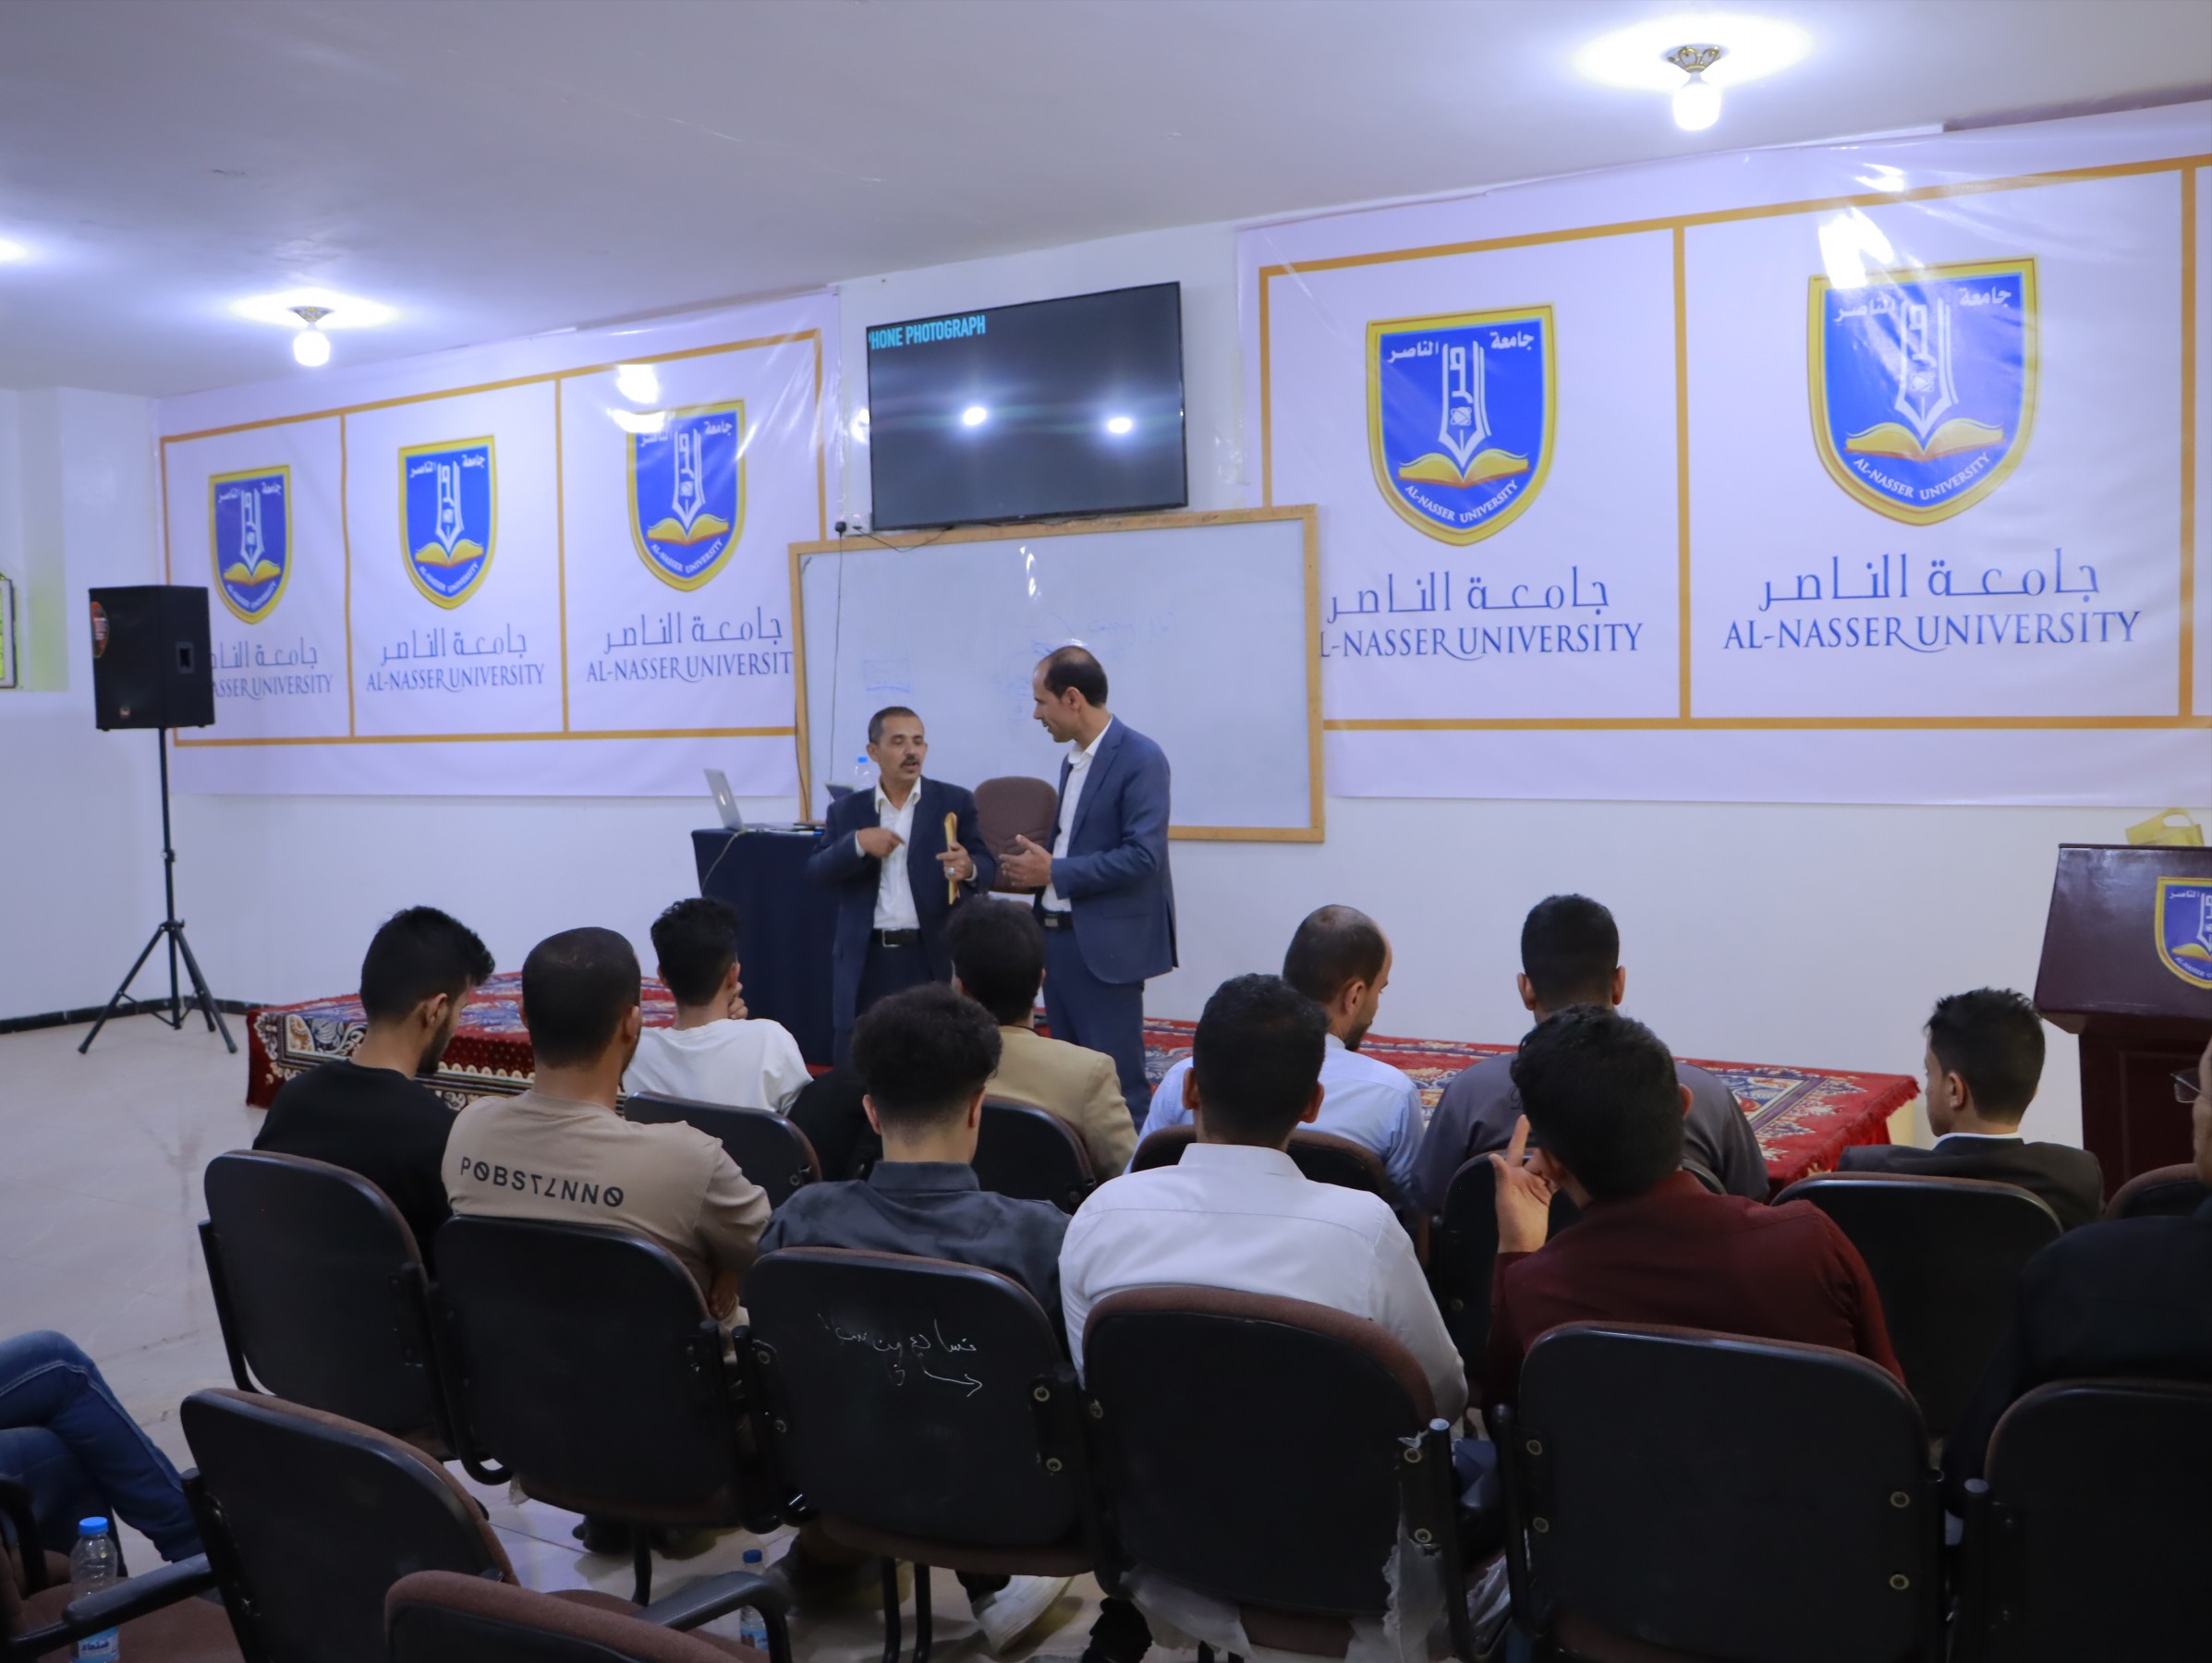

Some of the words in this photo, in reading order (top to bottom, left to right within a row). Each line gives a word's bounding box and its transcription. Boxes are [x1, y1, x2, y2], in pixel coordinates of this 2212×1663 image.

[1958, 286, 2012, 308] جامعة
[905, 315, 987, 346] PHOTOGRAPH
[1489, 331, 1535, 351] جامعة
[1388, 341, 1440, 364] الناصر
[703, 420, 733, 437] جامعة
[1853, 456, 1914, 499] AL-NASSER
[1919, 452, 1991, 501] UNIVERSITY
[1405, 484, 1456, 522] AL-NASSER
[1459, 479, 1519, 524] UNIVERSITY
[685, 538, 723, 574] UNIVERSITY
[1467, 565, 1610, 615] جامعة
[1758, 552, 1909, 612] الناصر
[1927, 547, 2100, 602] جامعة
[1327, 571, 1452, 624] الناصر
[453, 623, 528, 659] جامعة
[603, 611, 683, 655] الناصر
[691, 606, 783, 646] جامعة
[1319, 628, 1465, 661] L-NASSER
[1457, 622, 1645, 656] UNIVERSITY
[1723, 616, 1926, 653] AL-NASSER
[1914, 610, 2142, 647] UNIVERSITY
[212, 640, 249, 669] النا
[255, 637, 318, 670] جامعة
[380, 627, 446, 666] الناصر
[366, 668, 451, 693] AL-NASSER
[449, 663, 545, 688] UNIVERSITY
[586, 657, 690, 683] AL-NASSER
[686, 650, 795, 679] UNIVERSIT
[213, 677, 255, 699] ASSER
[252, 674, 334, 696] UNIVERSITY
